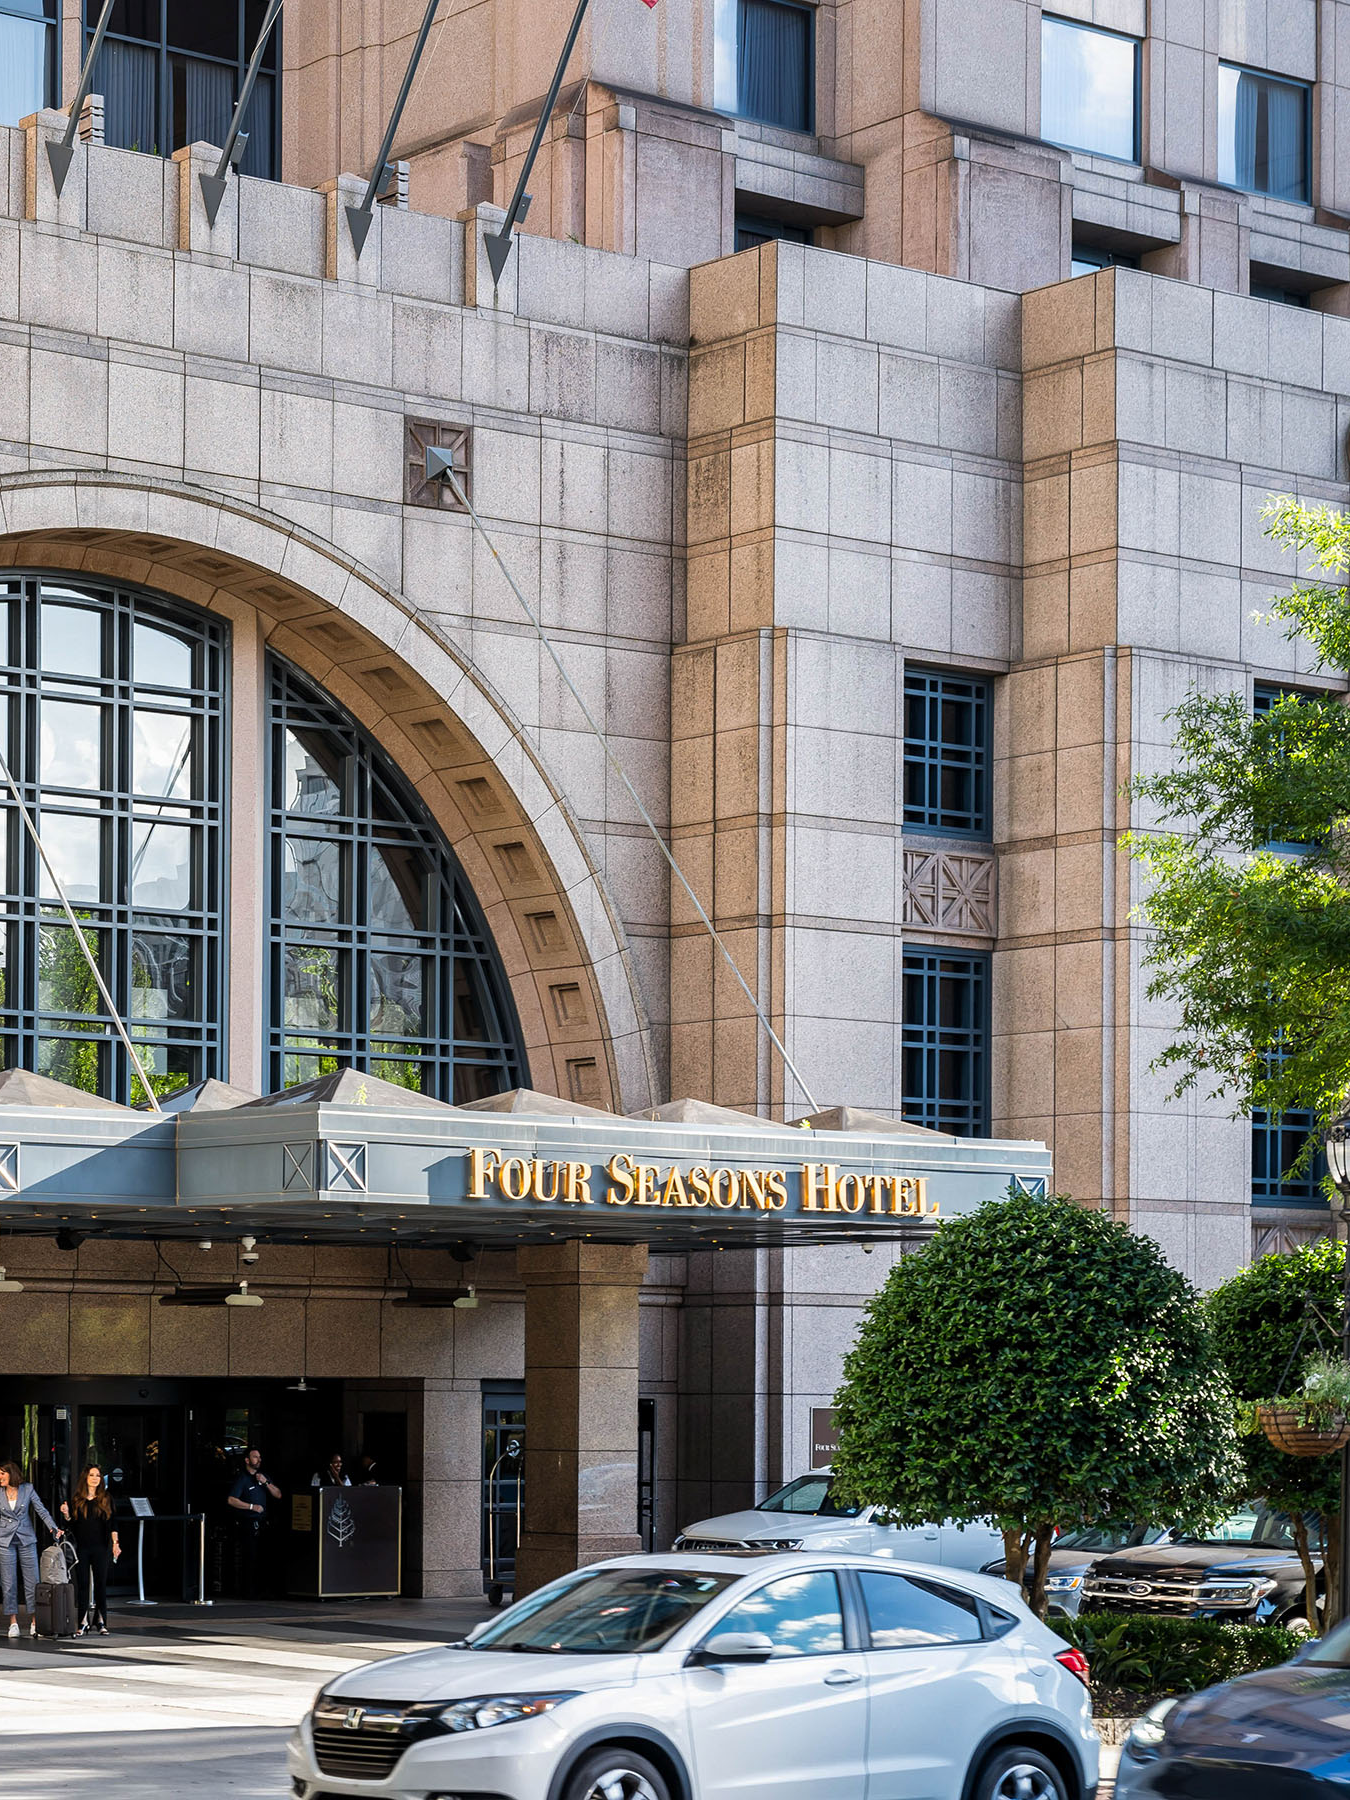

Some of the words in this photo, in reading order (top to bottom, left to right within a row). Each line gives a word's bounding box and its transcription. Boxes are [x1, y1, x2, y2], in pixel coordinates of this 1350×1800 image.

[466, 1146, 595, 1204] FOUR
[606, 1152, 788, 1211] SEASONS
[800, 1162, 940, 1216] HOTEL
